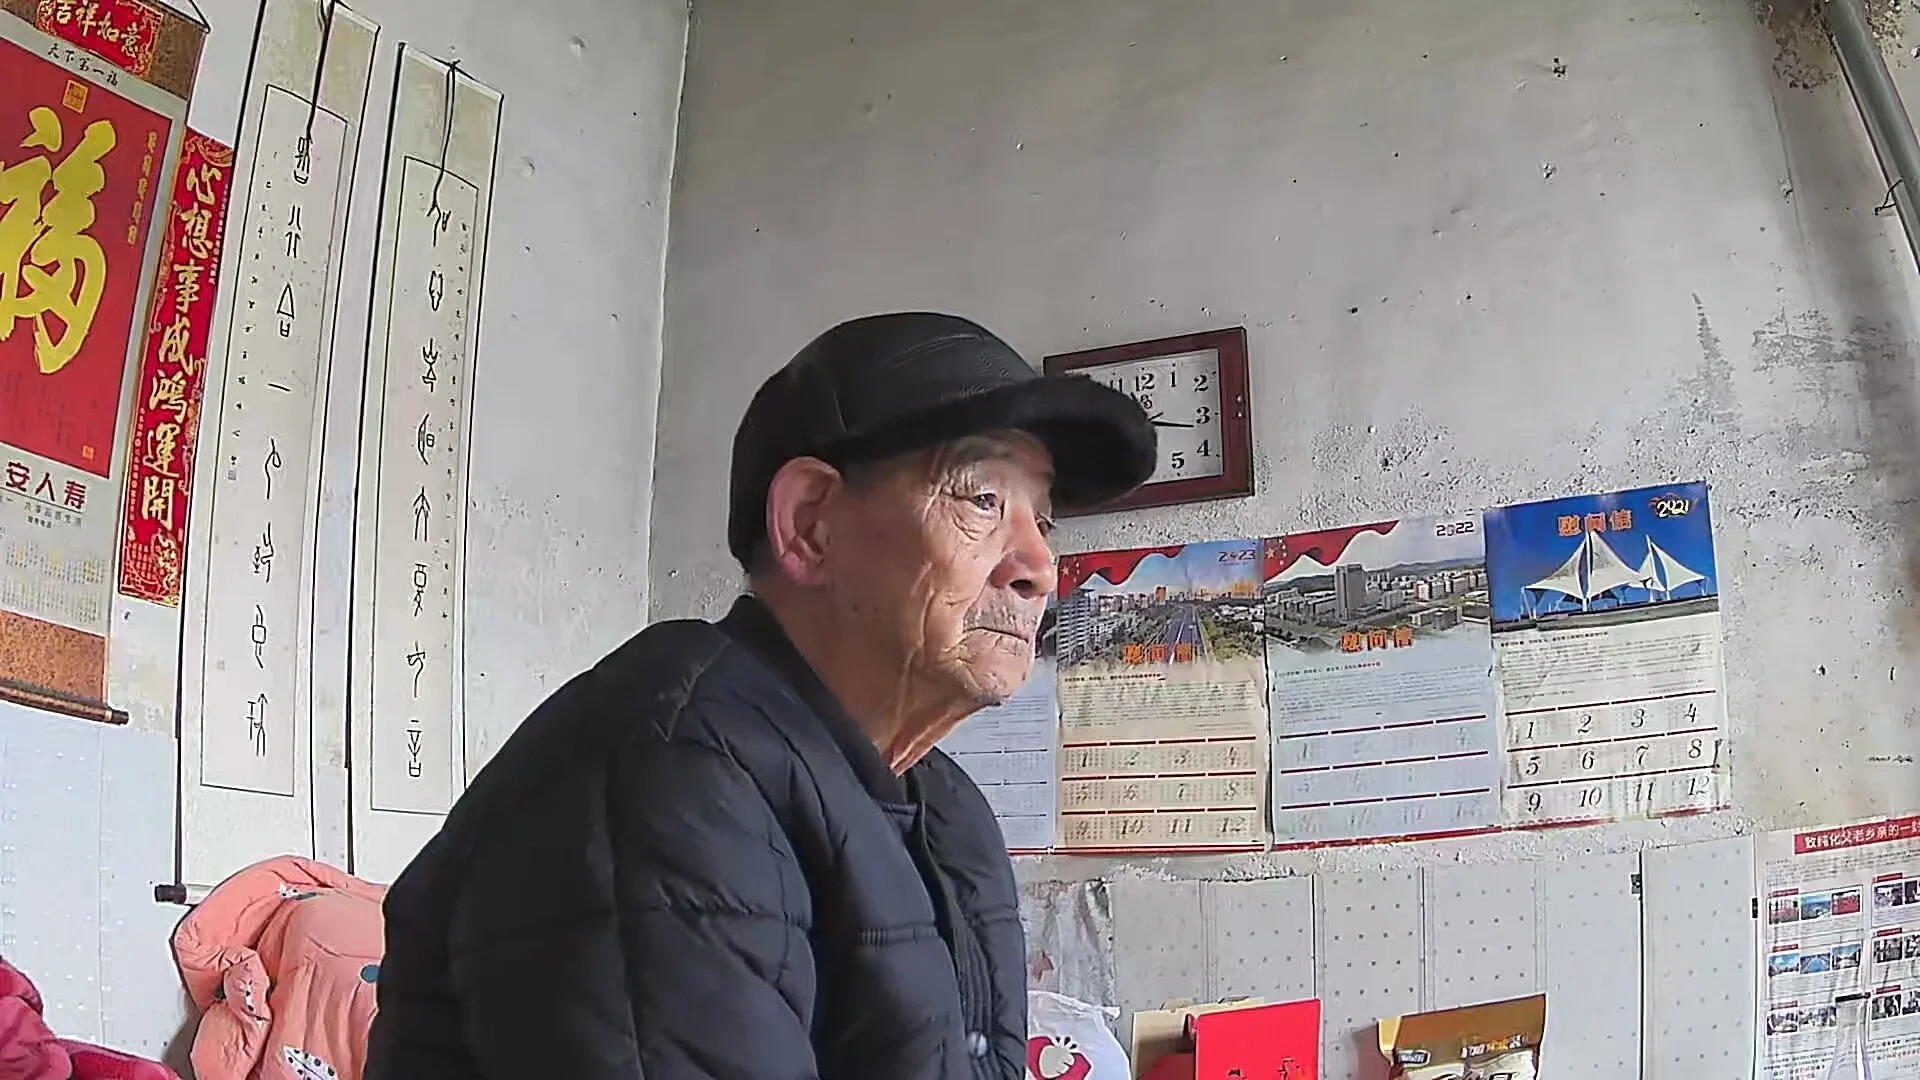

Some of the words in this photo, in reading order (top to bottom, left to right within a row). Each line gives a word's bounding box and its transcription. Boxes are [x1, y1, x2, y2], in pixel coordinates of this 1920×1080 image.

[57, 0, 141, 57] 吉祥如意
[1135, 373, 1155, 392] 12
[1171, 371, 1177, 388] 1
[1193, 376, 1209, 392] 2
[1196, 406, 1210, 425] 3
[1196, 439, 1210, 457] 4
[1171, 452, 1185, 469] 5
[6, 461, 86, 510] 安人寿
[1436, 522, 1474, 537] 2022
[1525, 721, 1535, 739] 1
[1577, 713, 1592, 733] 2
[1631, 708, 1646, 728] 3
[1684, 702, 1697, 722] 4
[1526, 755, 1541, 776] 5
[1581, 750, 1595, 770] 6
[1636, 744, 1649, 766] 7
[1688, 738, 1702, 759] 8
[1528, 791, 1541, 813] 9
[1578, 786, 1602, 808] 10
[1634, 781, 1654, 802] 11
[1687, 776, 1710, 797] 12
